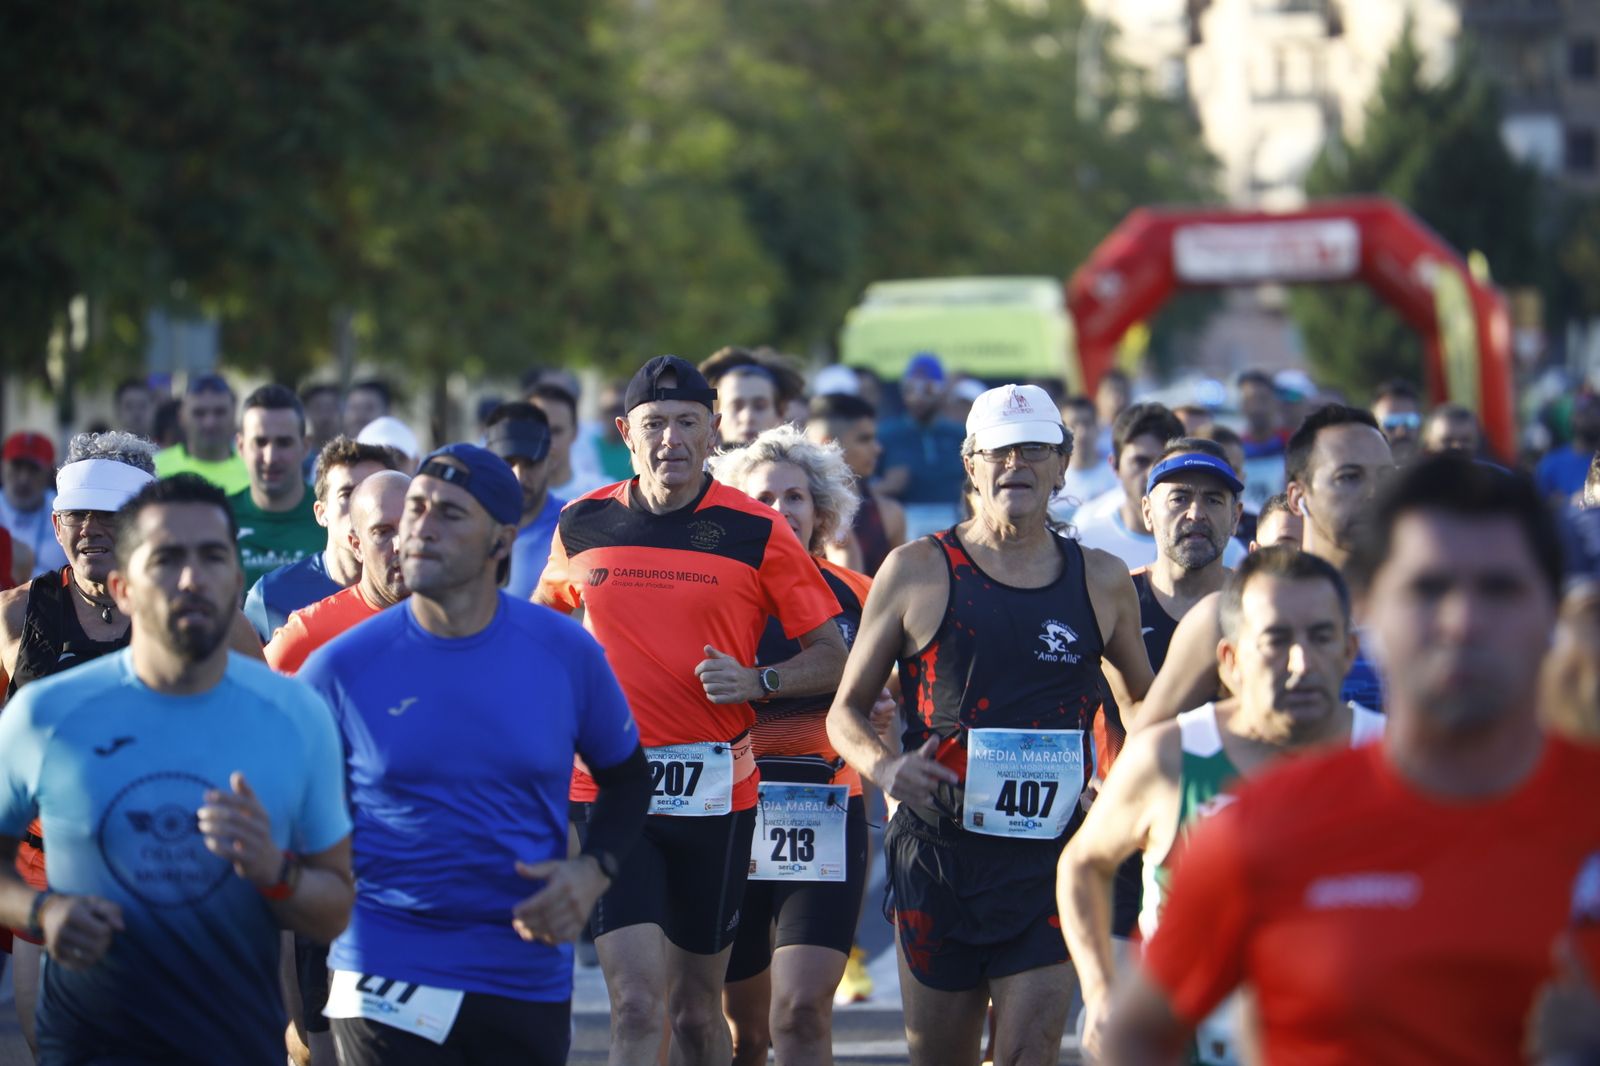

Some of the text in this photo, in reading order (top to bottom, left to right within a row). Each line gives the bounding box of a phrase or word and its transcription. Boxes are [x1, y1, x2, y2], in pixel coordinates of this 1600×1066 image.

[613, 567, 719, 586] CARBUROS MEDICA
[975, 748, 1080, 763] MEDIA MARATÓN
[647, 760, 704, 797] 207
[995, 779, 1059, 819] 407
[770, 827, 815, 863] 213
